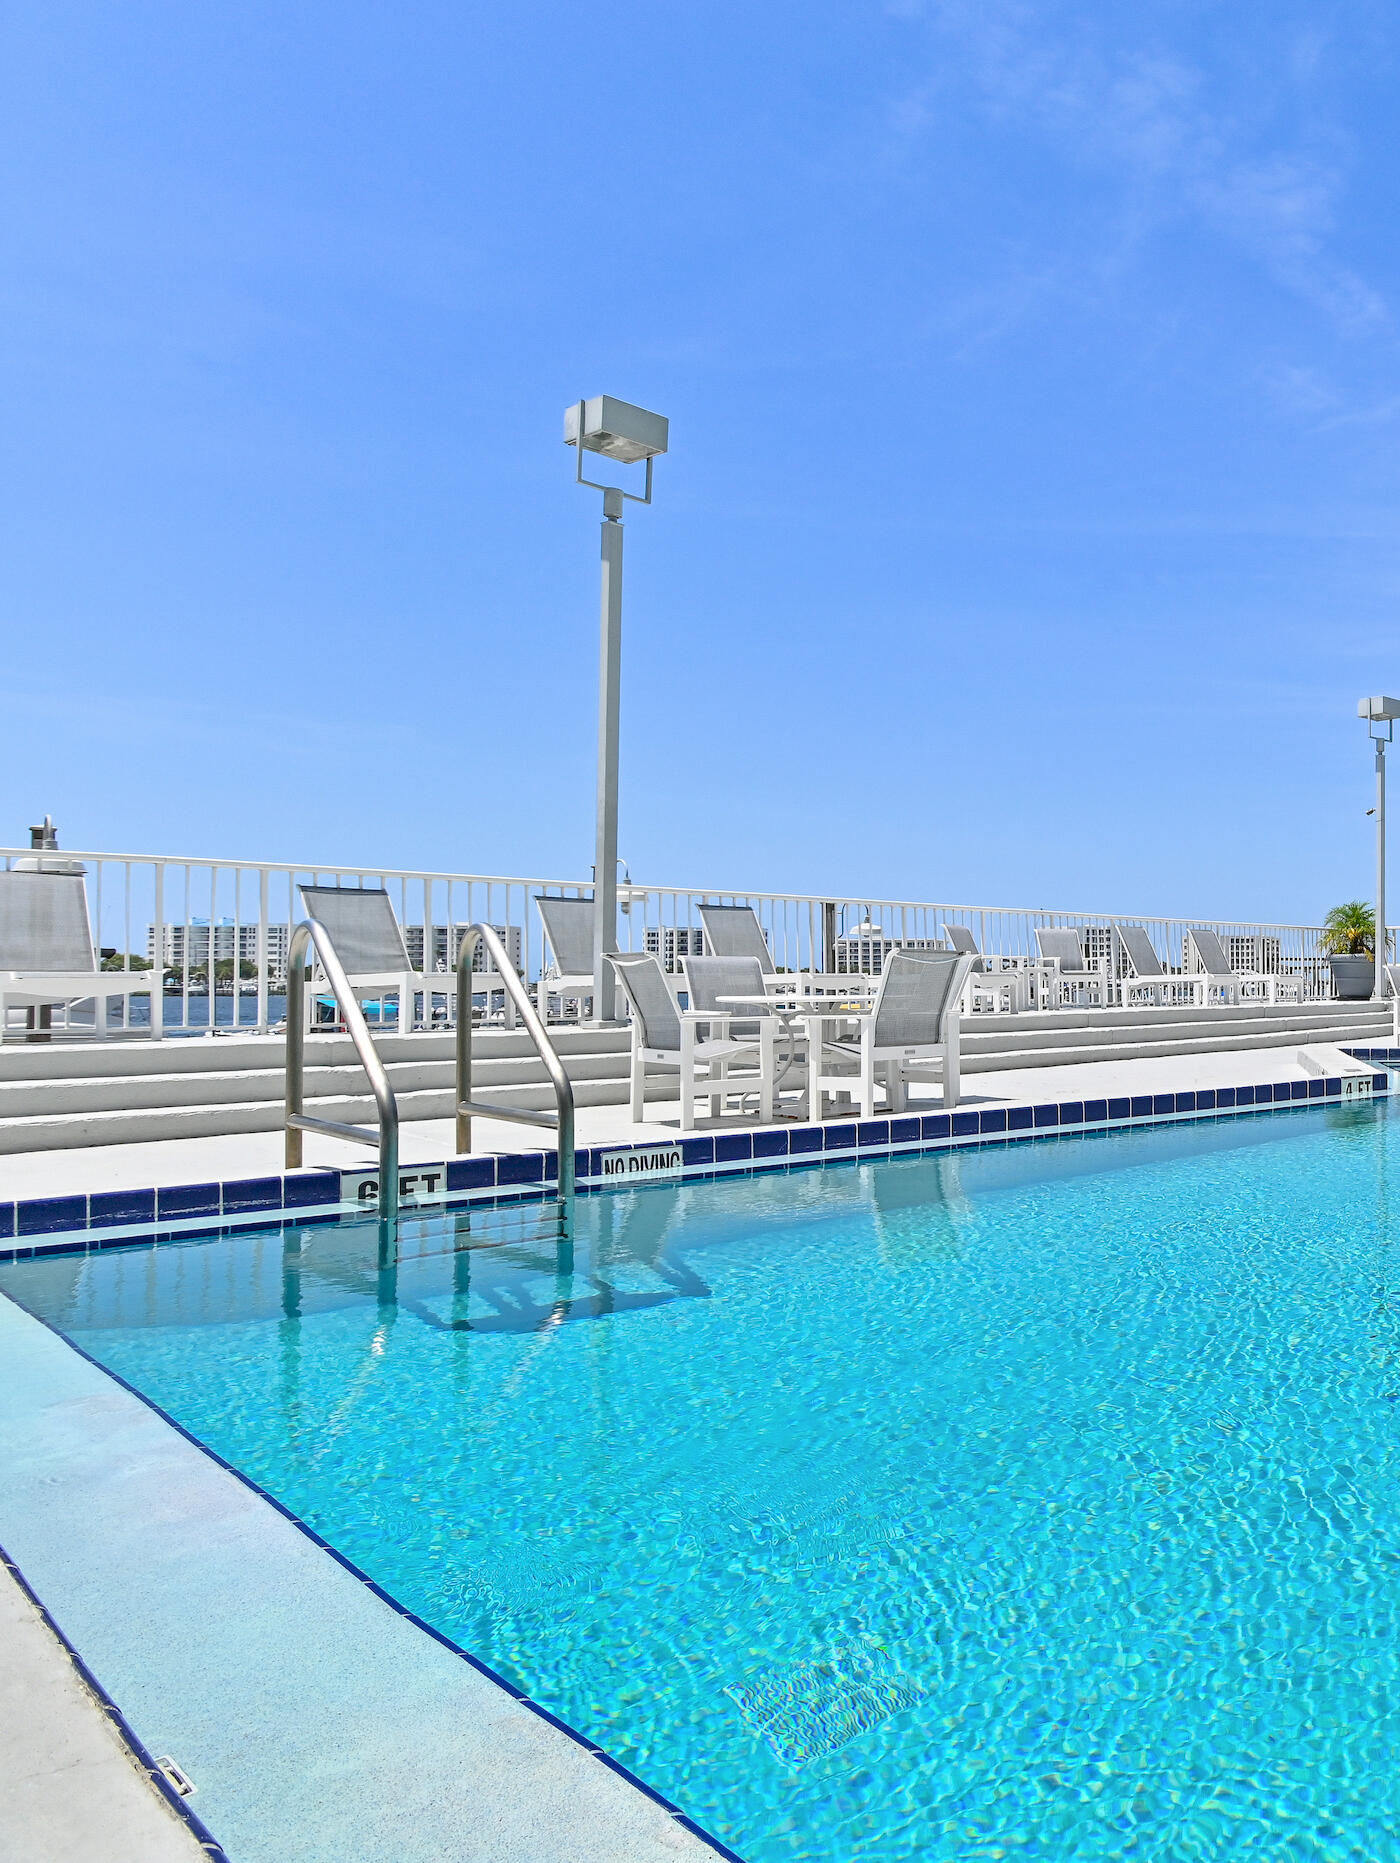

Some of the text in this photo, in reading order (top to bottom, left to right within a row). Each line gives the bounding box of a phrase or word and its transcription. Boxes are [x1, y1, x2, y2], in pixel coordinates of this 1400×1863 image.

[1345, 1080, 1371, 1094] 4 FT
[604, 1151, 680, 1175] NO DIVING
[399, 1173, 441, 1196] FT
